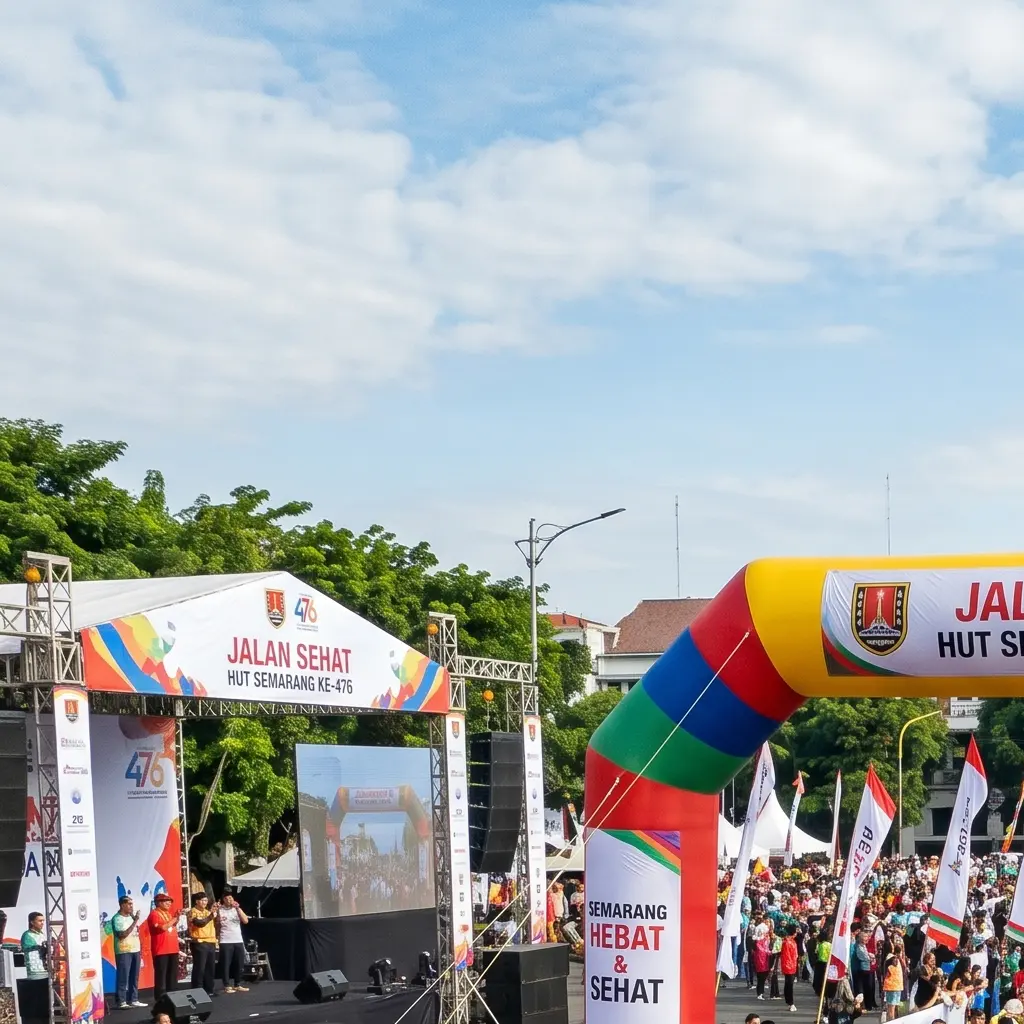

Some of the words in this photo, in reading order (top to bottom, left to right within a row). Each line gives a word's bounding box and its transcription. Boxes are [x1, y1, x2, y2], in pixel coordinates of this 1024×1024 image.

[294, 598, 318, 623] 476
[227, 637, 290, 668] JALAN
[297, 643, 352, 674] SEHAT
[938, 631, 991, 658] HUT
[227, 669, 250, 687] HUT
[254, 671, 315, 692] SEMARANG
[318, 677, 353, 694] KE-476
[125, 752, 164, 787] 476
[589, 901, 667, 920] SEMARANG
[590, 923, 664, 951] HEBAT
[614, 955, 628, 974] &
[590, 975, 664, 1004] SEHAT
